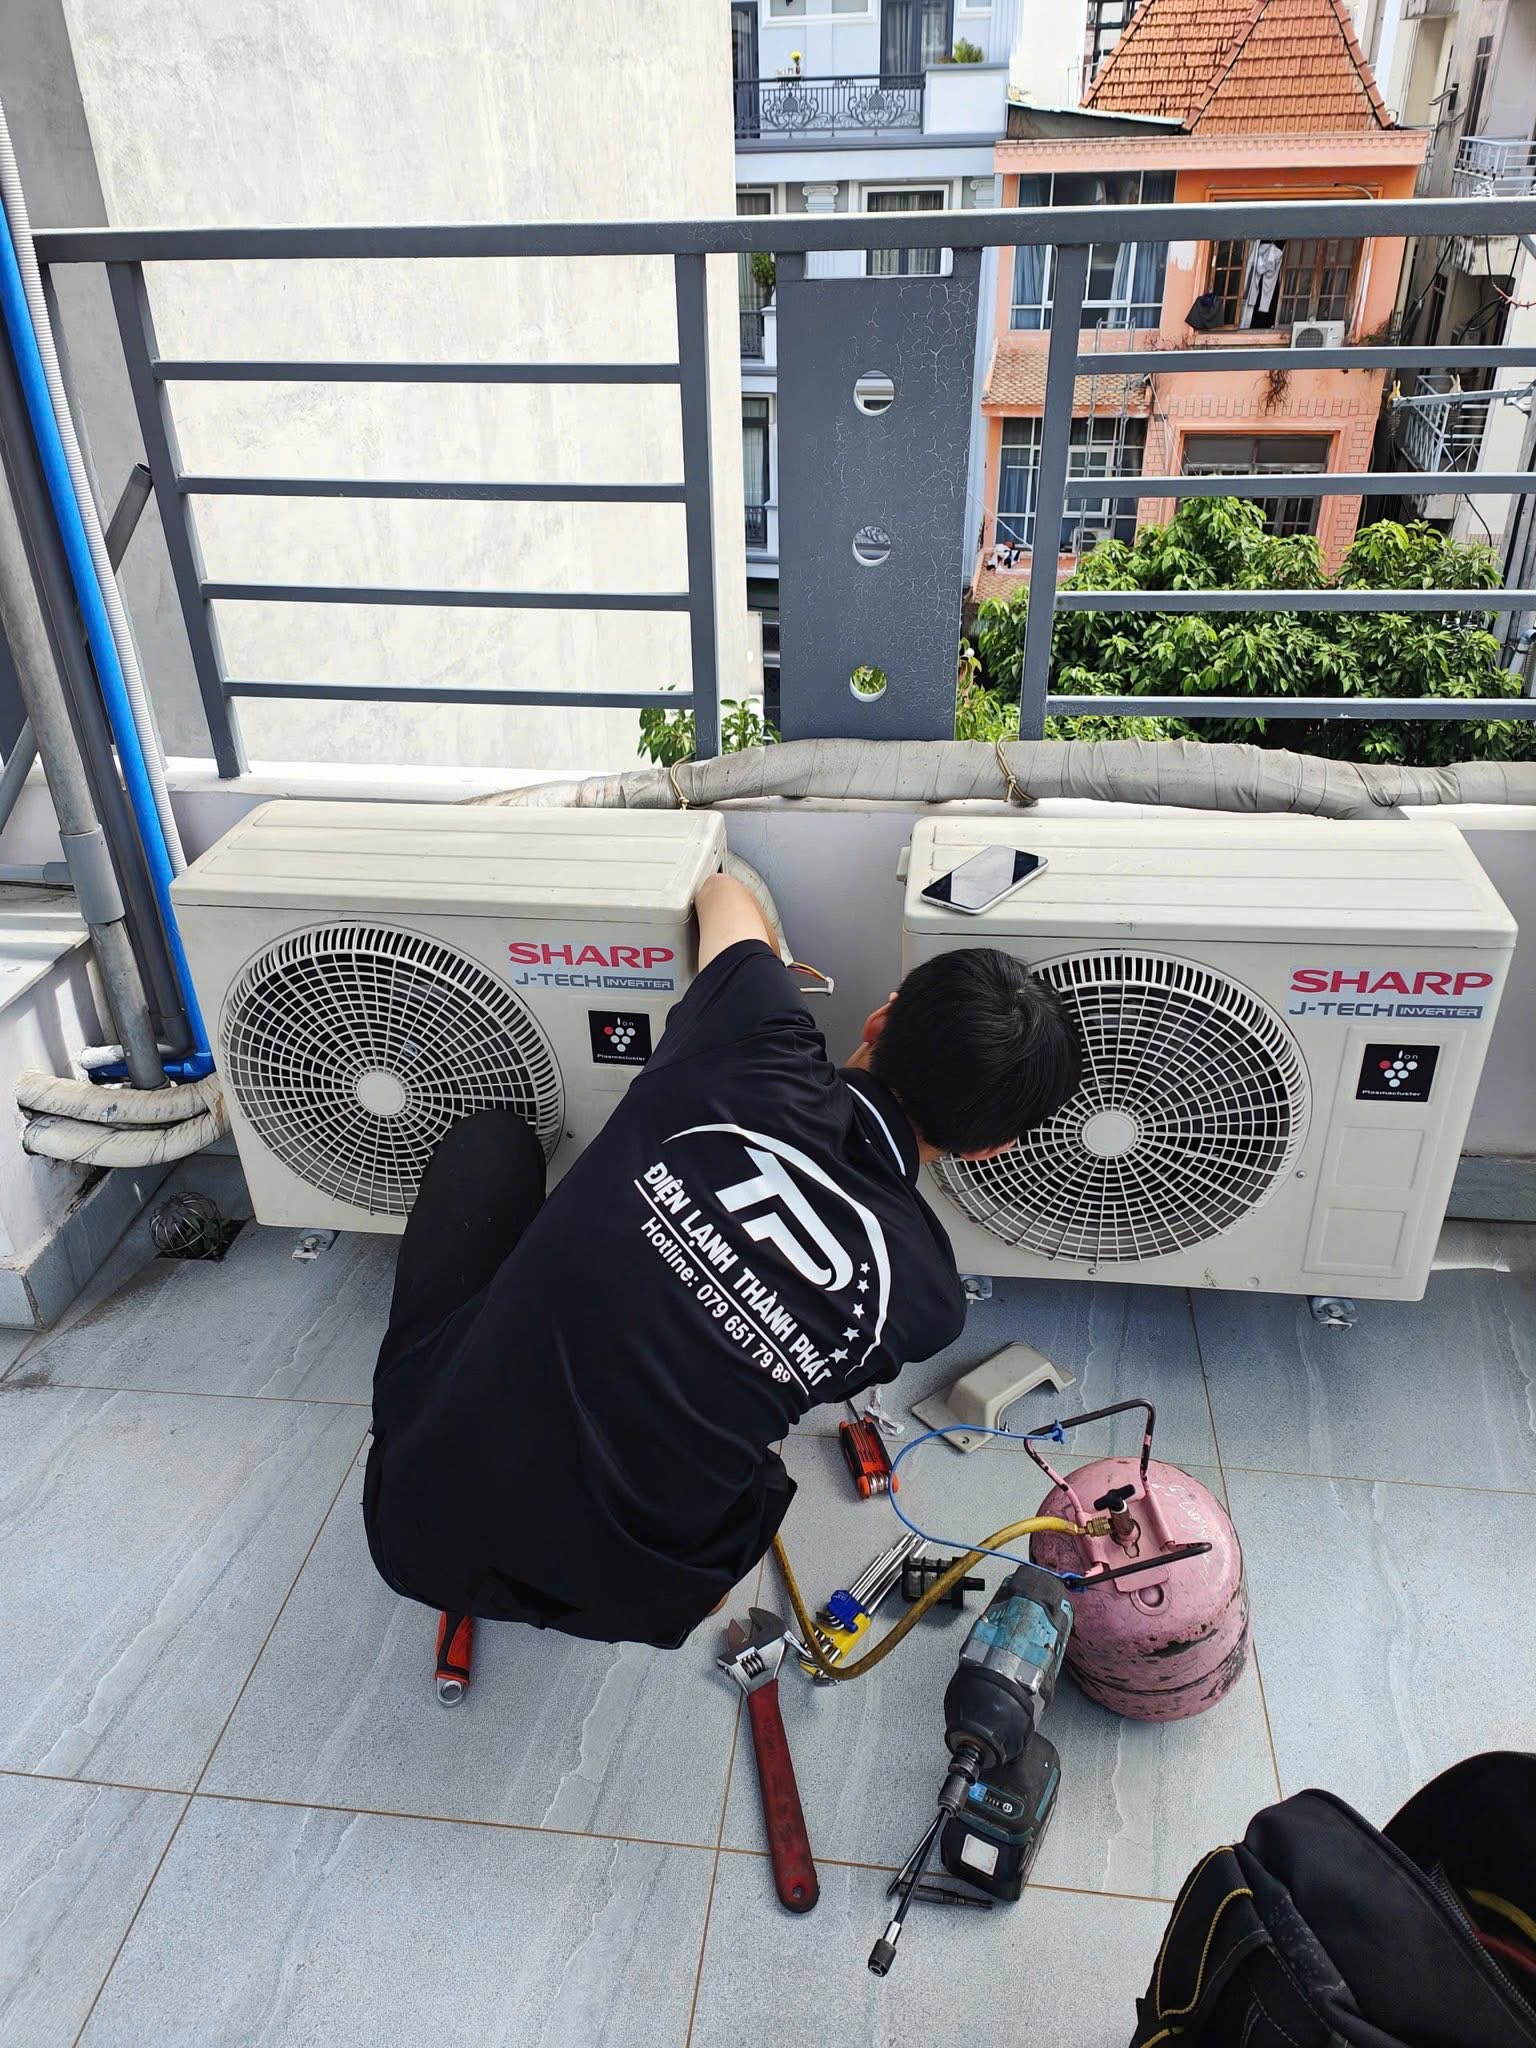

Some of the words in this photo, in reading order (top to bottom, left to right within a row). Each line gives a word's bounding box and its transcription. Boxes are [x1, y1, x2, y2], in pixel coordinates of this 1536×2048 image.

[508, 942, 674, 969] SHARP
[515, 972, 602, 988] J-TECH
[606, 976, 671, 989] INVERTER
[1290, 969, 1493, 996] SHARP
[1288, 1001, 1395, 1017] J-TECH
[1400, 1006, 1479, 1017] INVERTER
[617, 1017, 634, 1026] Ion
[1397, 1049, 1419, 1060] Ion
[1361, 1089, 1422, 1097] Plasmacluster
[643, 1161, 692, 1215] ĐIỆN
[680, 1209, 739, 1274] LẠNH
[732, 1266, 798, 1343] THÀNH
[788, 1333, 833, 1387] PHÁT
[640, 1216, 700, 1288] Hotline:
[696, 1283, 729, 1318] 079
[724, 1315, 756, 1349] 651
[751, 1342, 774, 1368] 79
